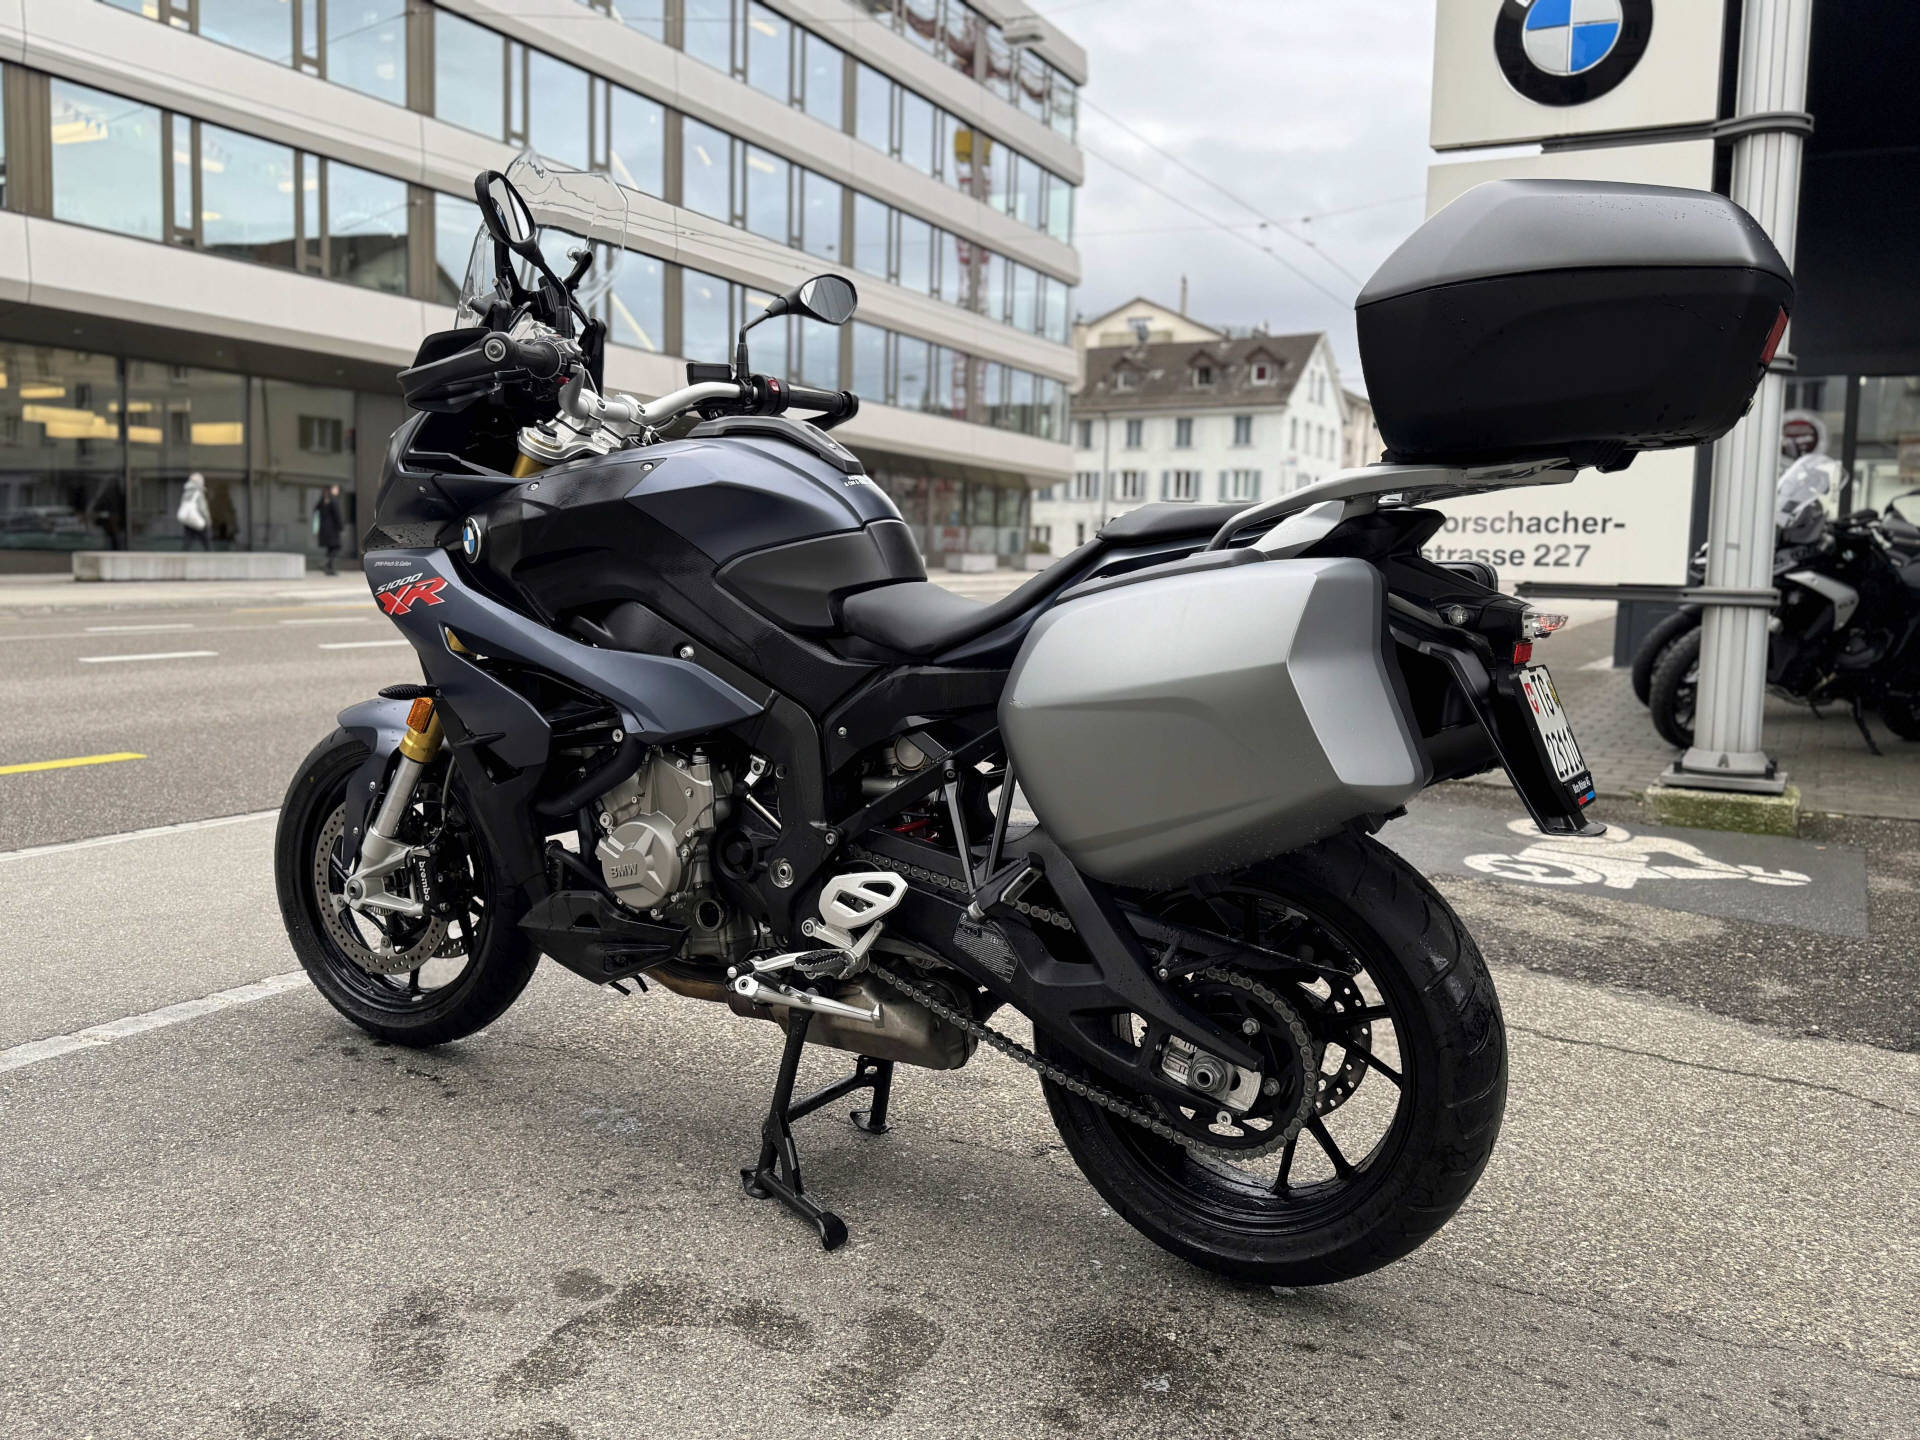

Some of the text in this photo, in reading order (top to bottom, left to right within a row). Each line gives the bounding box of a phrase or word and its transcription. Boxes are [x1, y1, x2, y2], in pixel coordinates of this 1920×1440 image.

[1441, 510, 1626, 534] orschacher-
[1533, 544, 1591, 567] 227
[377, 577, 448, 615] XR
[418, 860, 431, 902] brembo
[609, 862, 638, 879] BMW
